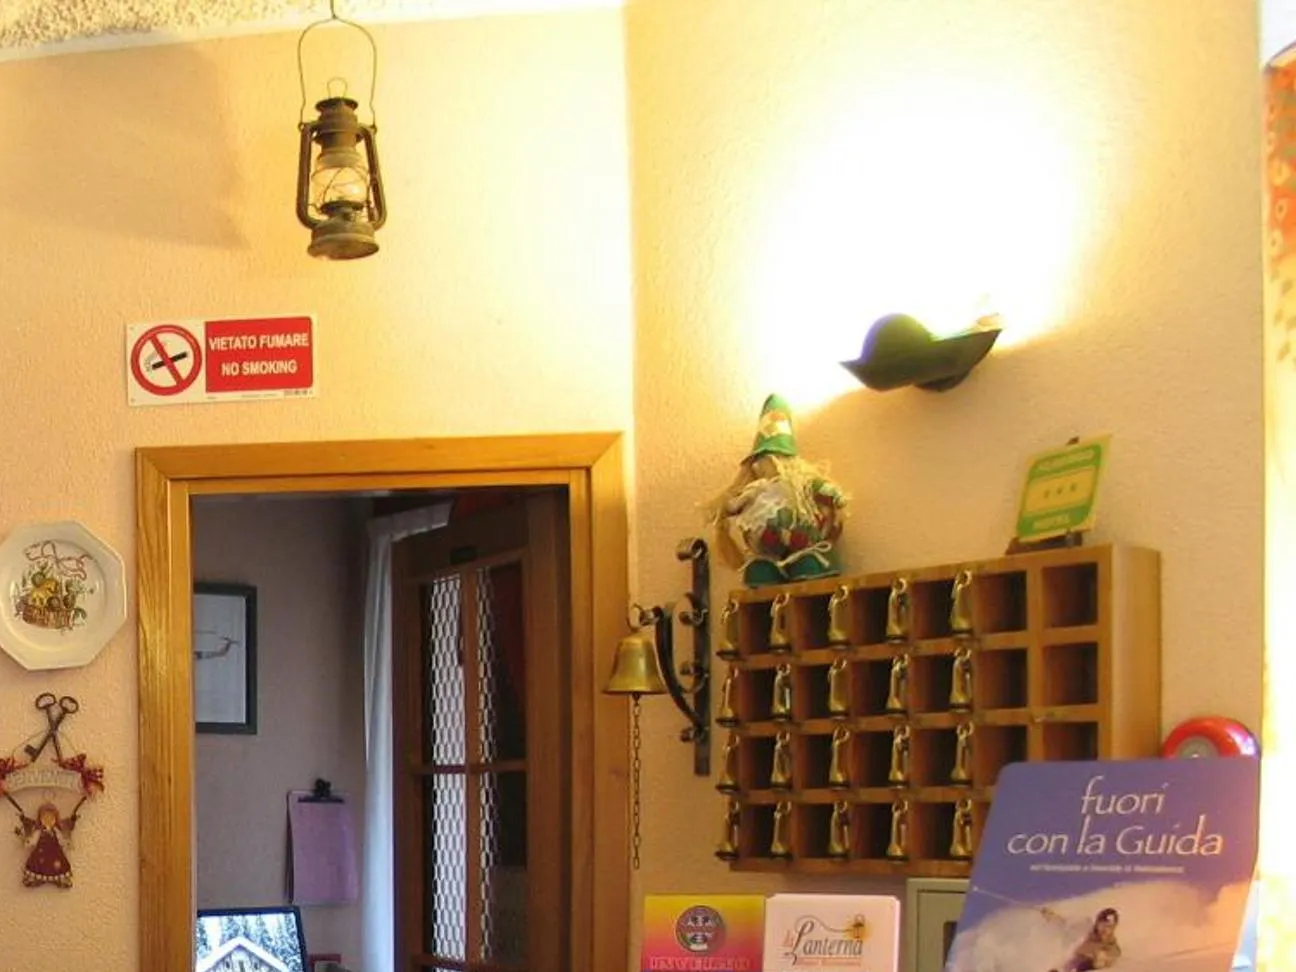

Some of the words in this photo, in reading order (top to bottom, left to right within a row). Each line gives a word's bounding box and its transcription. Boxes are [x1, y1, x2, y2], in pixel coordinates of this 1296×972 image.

[209, 336, 256, 351] VIETATO
[259, 332, 309, 349] FUMARE
[221, 362, 240, 376] NO
[242, 360, 297, 375] SMOKING
[1080, 775, 1169, 815] fuori
[1007, 832, 1068, 855] con
[1076, 814, 1106, 855] la
[1115, 813, 1224, 856] Guida
[784, 919, 863, 966] Lanterna
